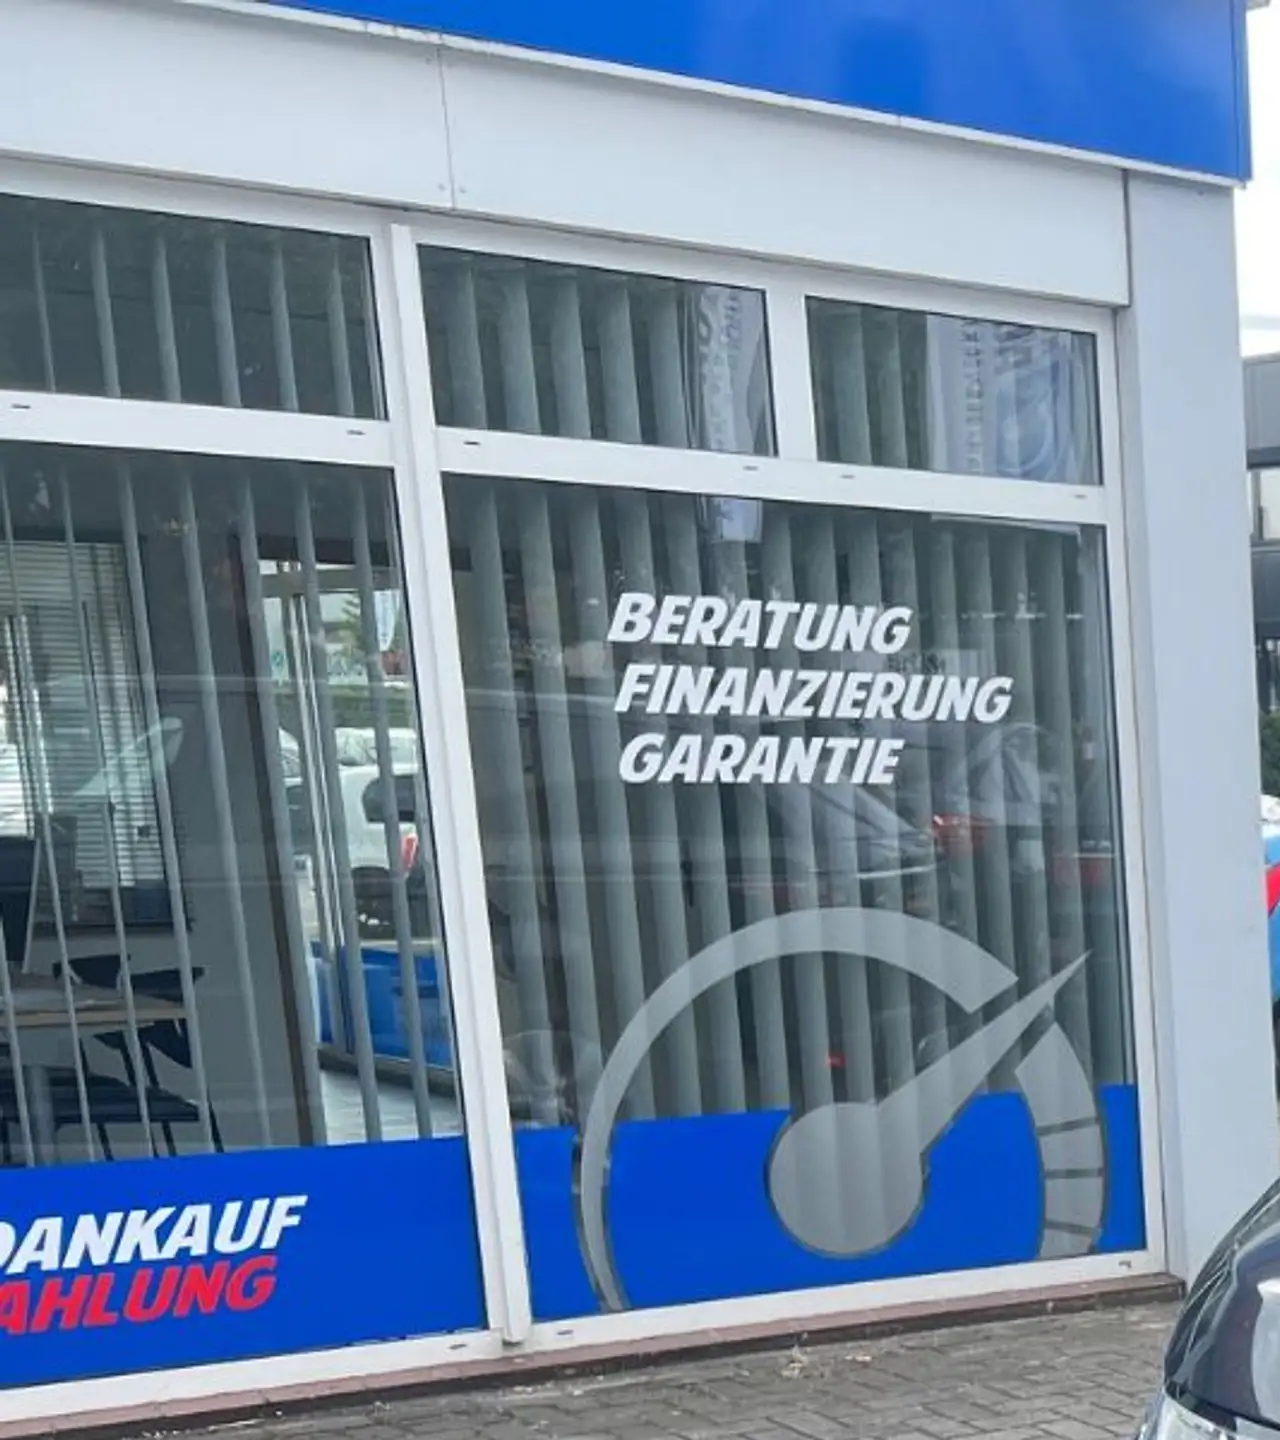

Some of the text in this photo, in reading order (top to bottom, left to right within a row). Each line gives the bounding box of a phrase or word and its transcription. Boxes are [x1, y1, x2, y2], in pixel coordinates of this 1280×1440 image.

[607, 592, 914, 655] BERATUNG
[614, 663, 1014, 723] FINANZIERUNG
[618, 733, 905, 785] GARANTIE
